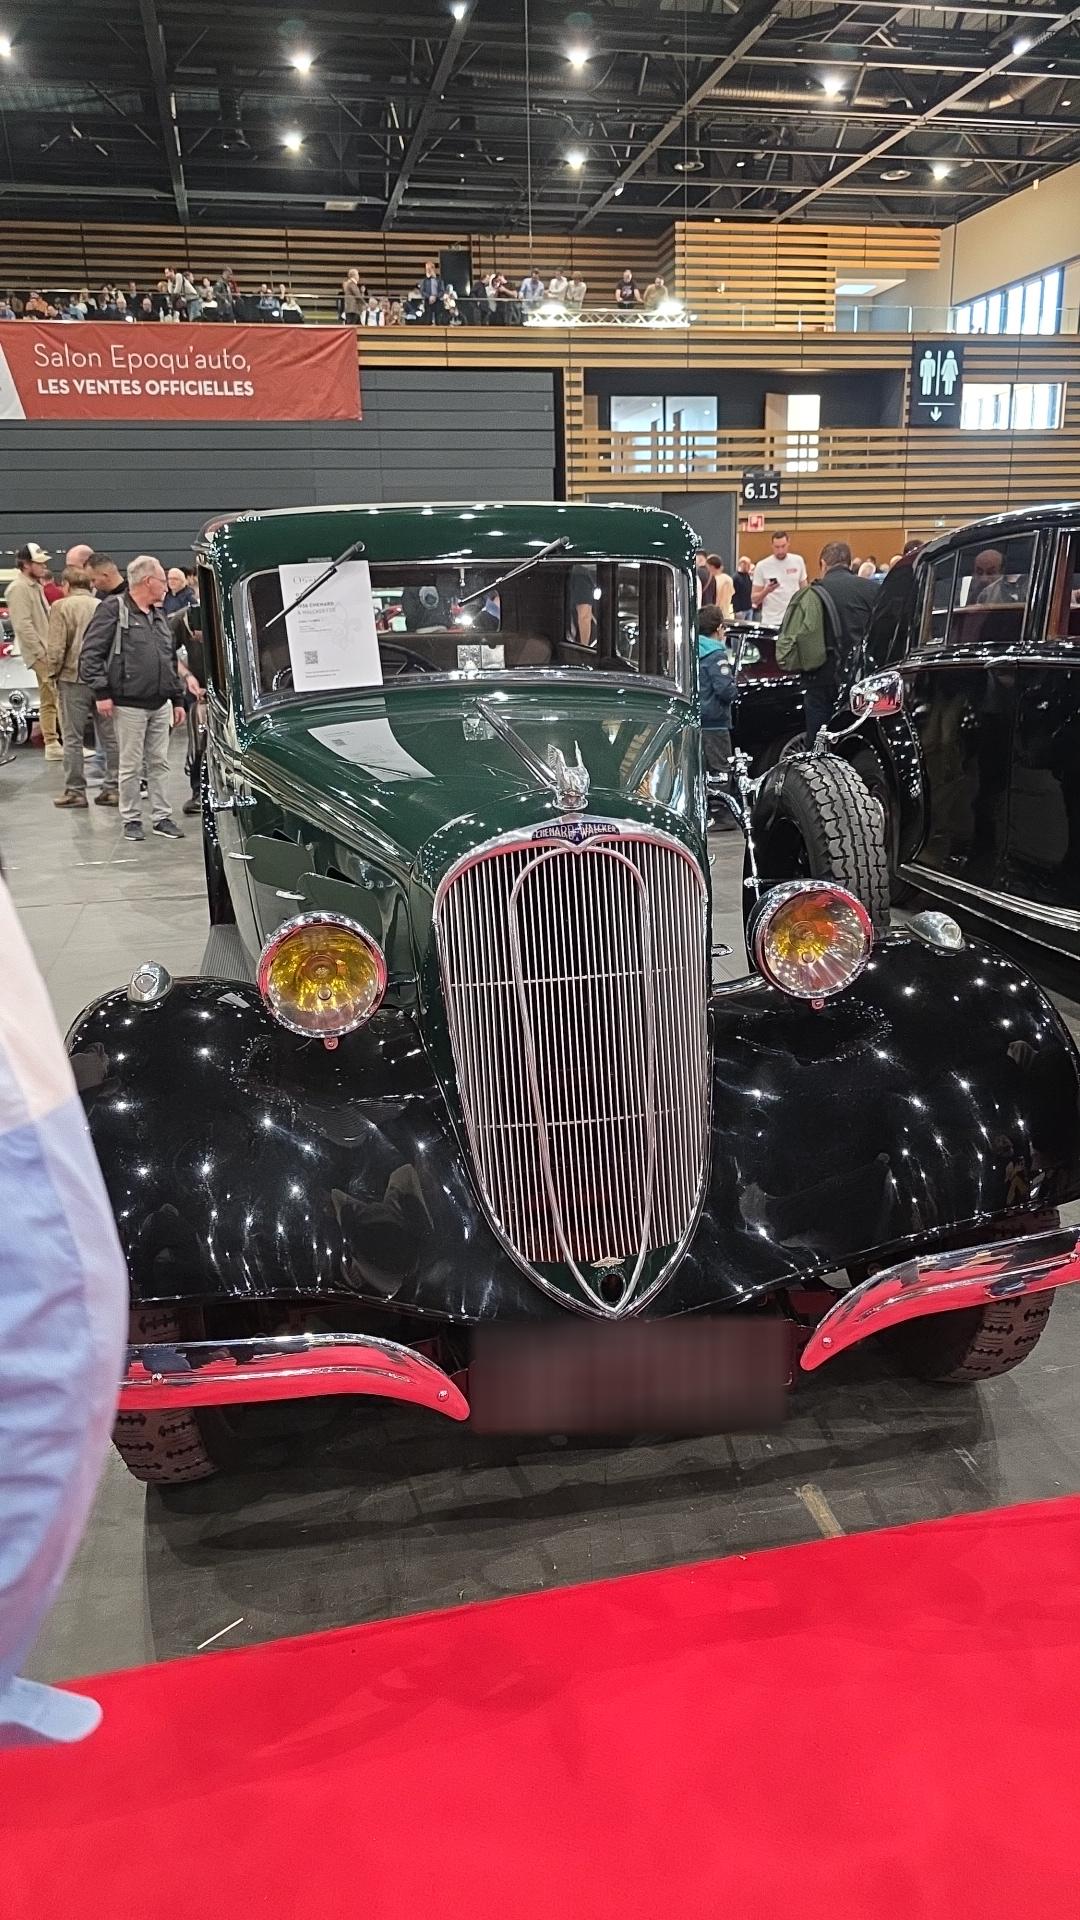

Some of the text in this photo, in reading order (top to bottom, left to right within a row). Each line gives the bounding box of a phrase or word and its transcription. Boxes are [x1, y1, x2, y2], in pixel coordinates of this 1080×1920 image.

[34, 342, 252, 375] Salon Epoqu'auto,
[37, 378, 254, 397] LES VENTES OFFICIELLES
[744, 482, 778, 499] 6.15
[579, 823, 617, 839] WALCKER
